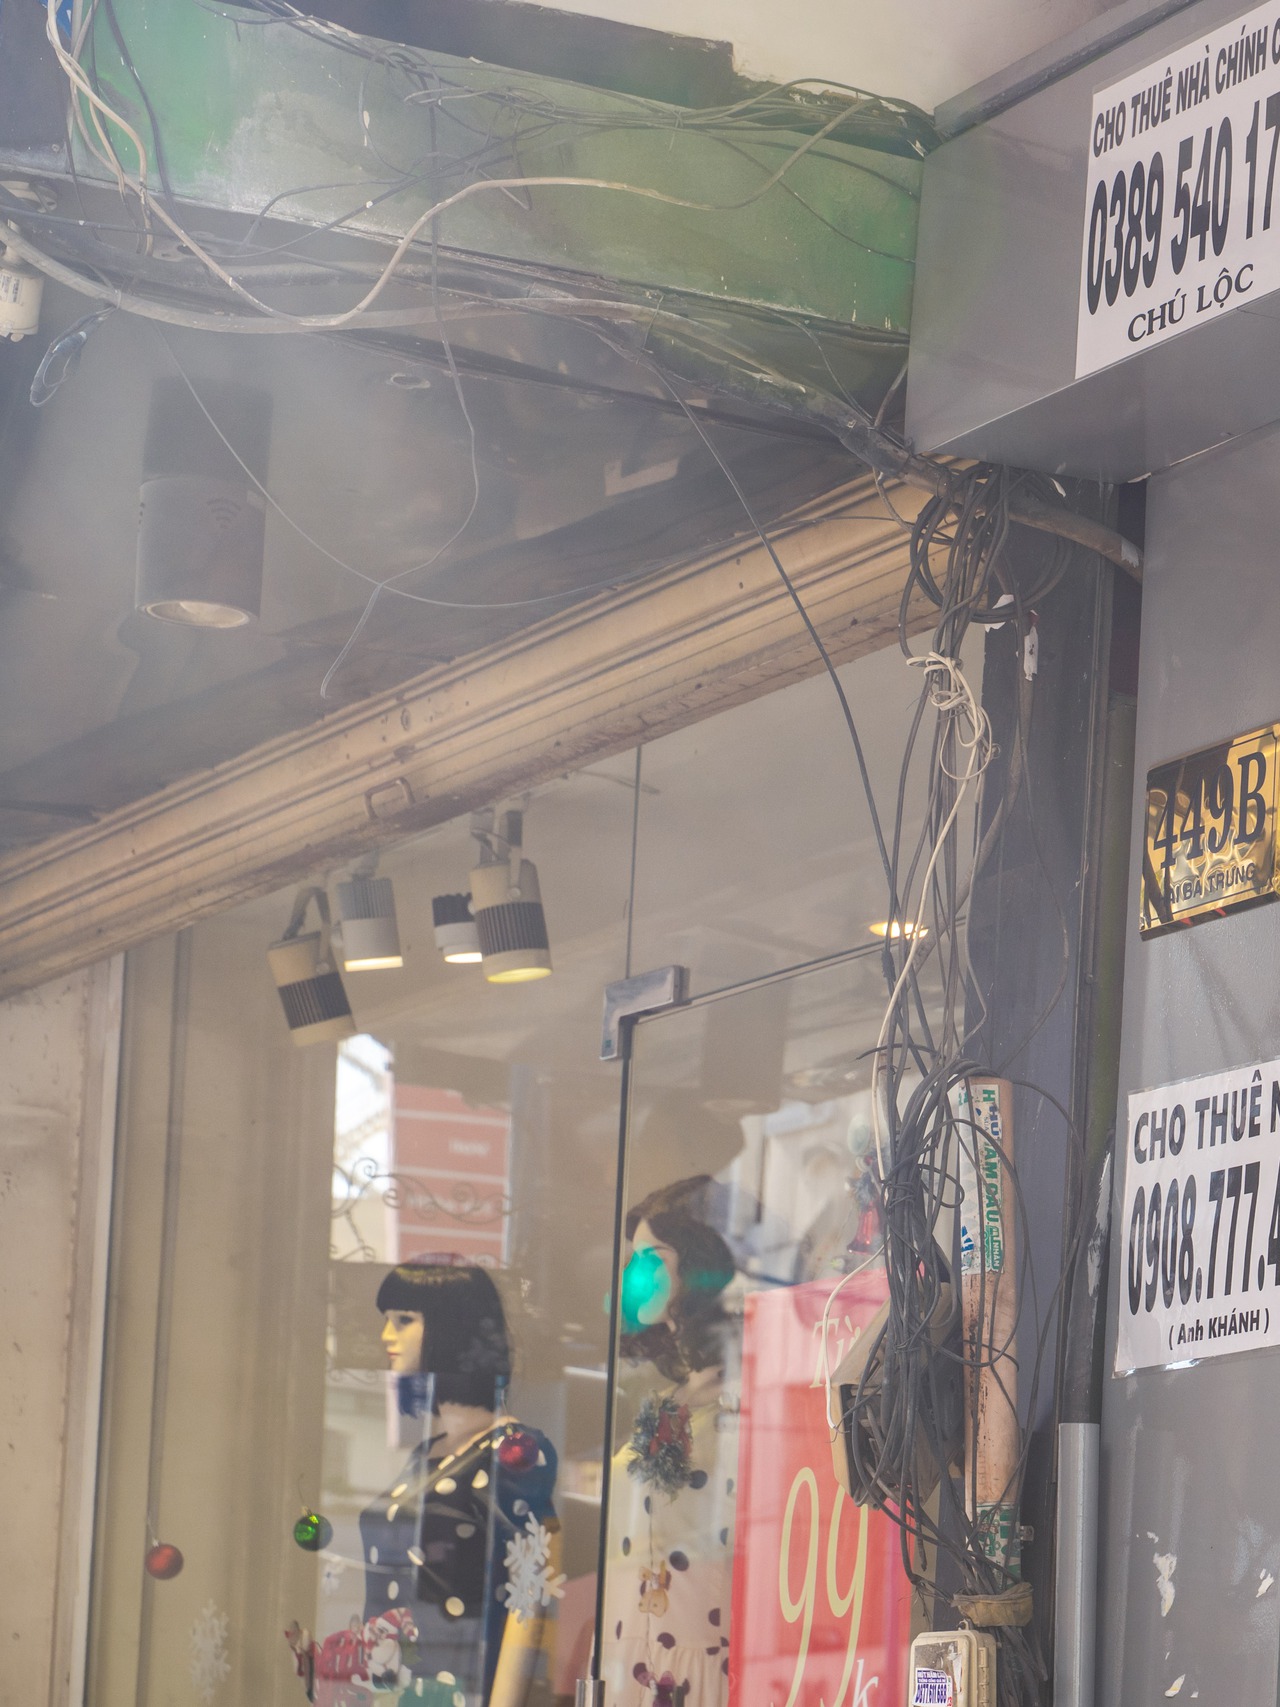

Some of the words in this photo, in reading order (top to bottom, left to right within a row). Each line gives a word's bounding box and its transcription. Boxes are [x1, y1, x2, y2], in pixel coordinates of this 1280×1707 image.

[1093, 101, 1126, 158] CHO
[1131, 67, 1172, 138] THUÊ
[1175, 45, 1210, 115] NHÀ
[1215, 24, 1268, 95] CHÍNH
[1087, 151, 1164, 315] 0389
[1171, 117, 1232, 275] 540
[1128, 288, 1187, 342] CHÚ
[1196, 263, 1254, 314] LỘC
[1154, 751, 1267, 868] 449B
[1133, 1103, 1187, 1164] CHO
[1194, 1069, 1262, 1150] THUÊ
[1176, 1319, 1204, 1345] Anh
[1208, 1308, 1260, 1339] KHÁNH
